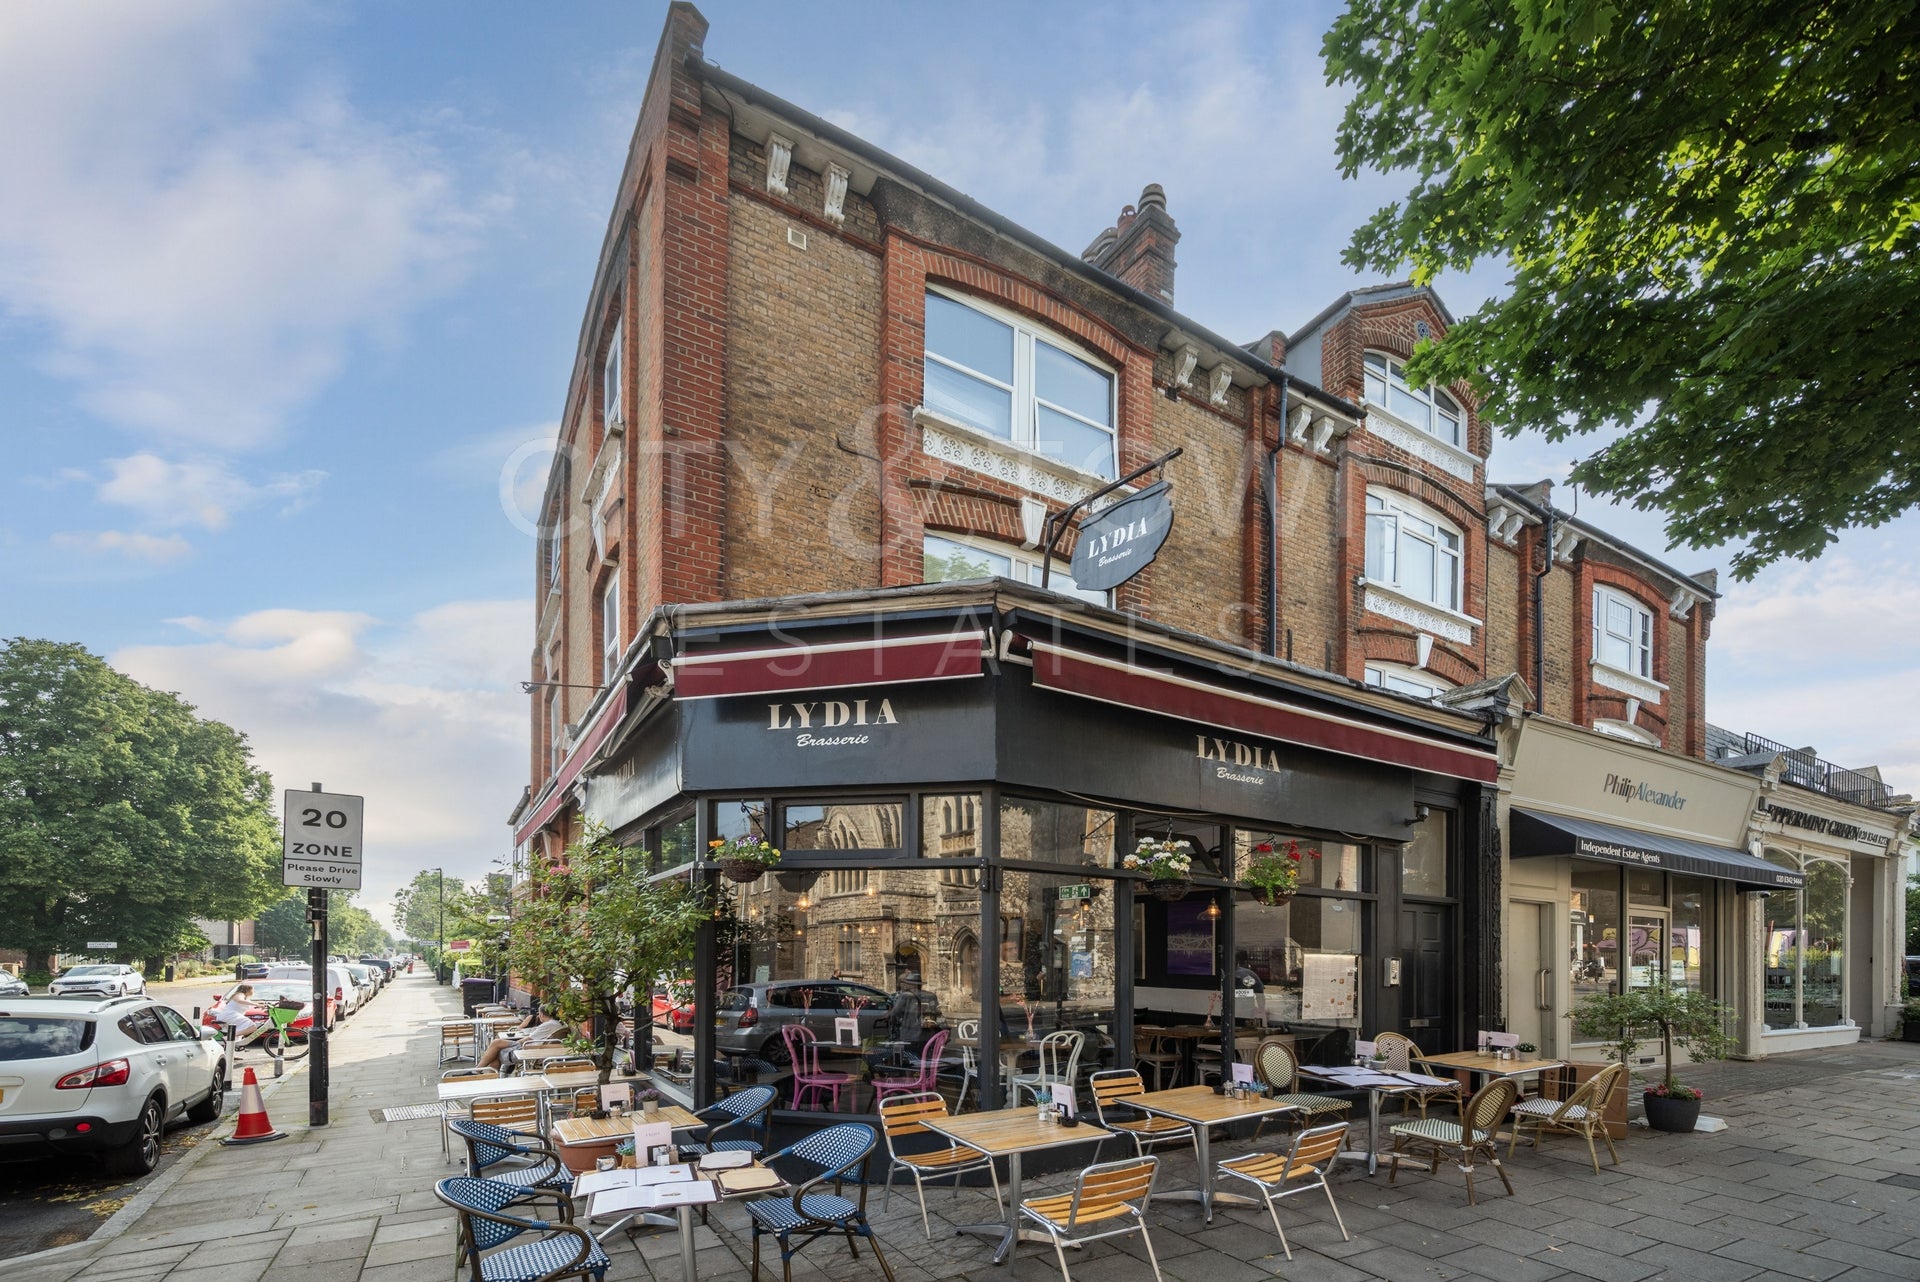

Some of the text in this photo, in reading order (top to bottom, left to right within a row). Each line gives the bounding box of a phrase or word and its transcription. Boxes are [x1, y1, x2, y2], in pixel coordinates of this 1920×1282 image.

[1088, 517, 1147, 559] LYDIA
[1098, 548, 1133, 567] Brasserie
[767, 698, 899, 730] LYDIA
[796, 733, 869, 747] Brasserie
[1196, 734, 1280, 773] LYDIA
[1217, 767, 1264, 785] Brasserie
[302, 808, 347, 829] 20
[293, 843, 353, 858] ZONE
[1581, 840, 1660, 864] Independent Estate Agents
[287, 863, 358, 875] Please Drive
[303, 875, 342, 884] Slowly
